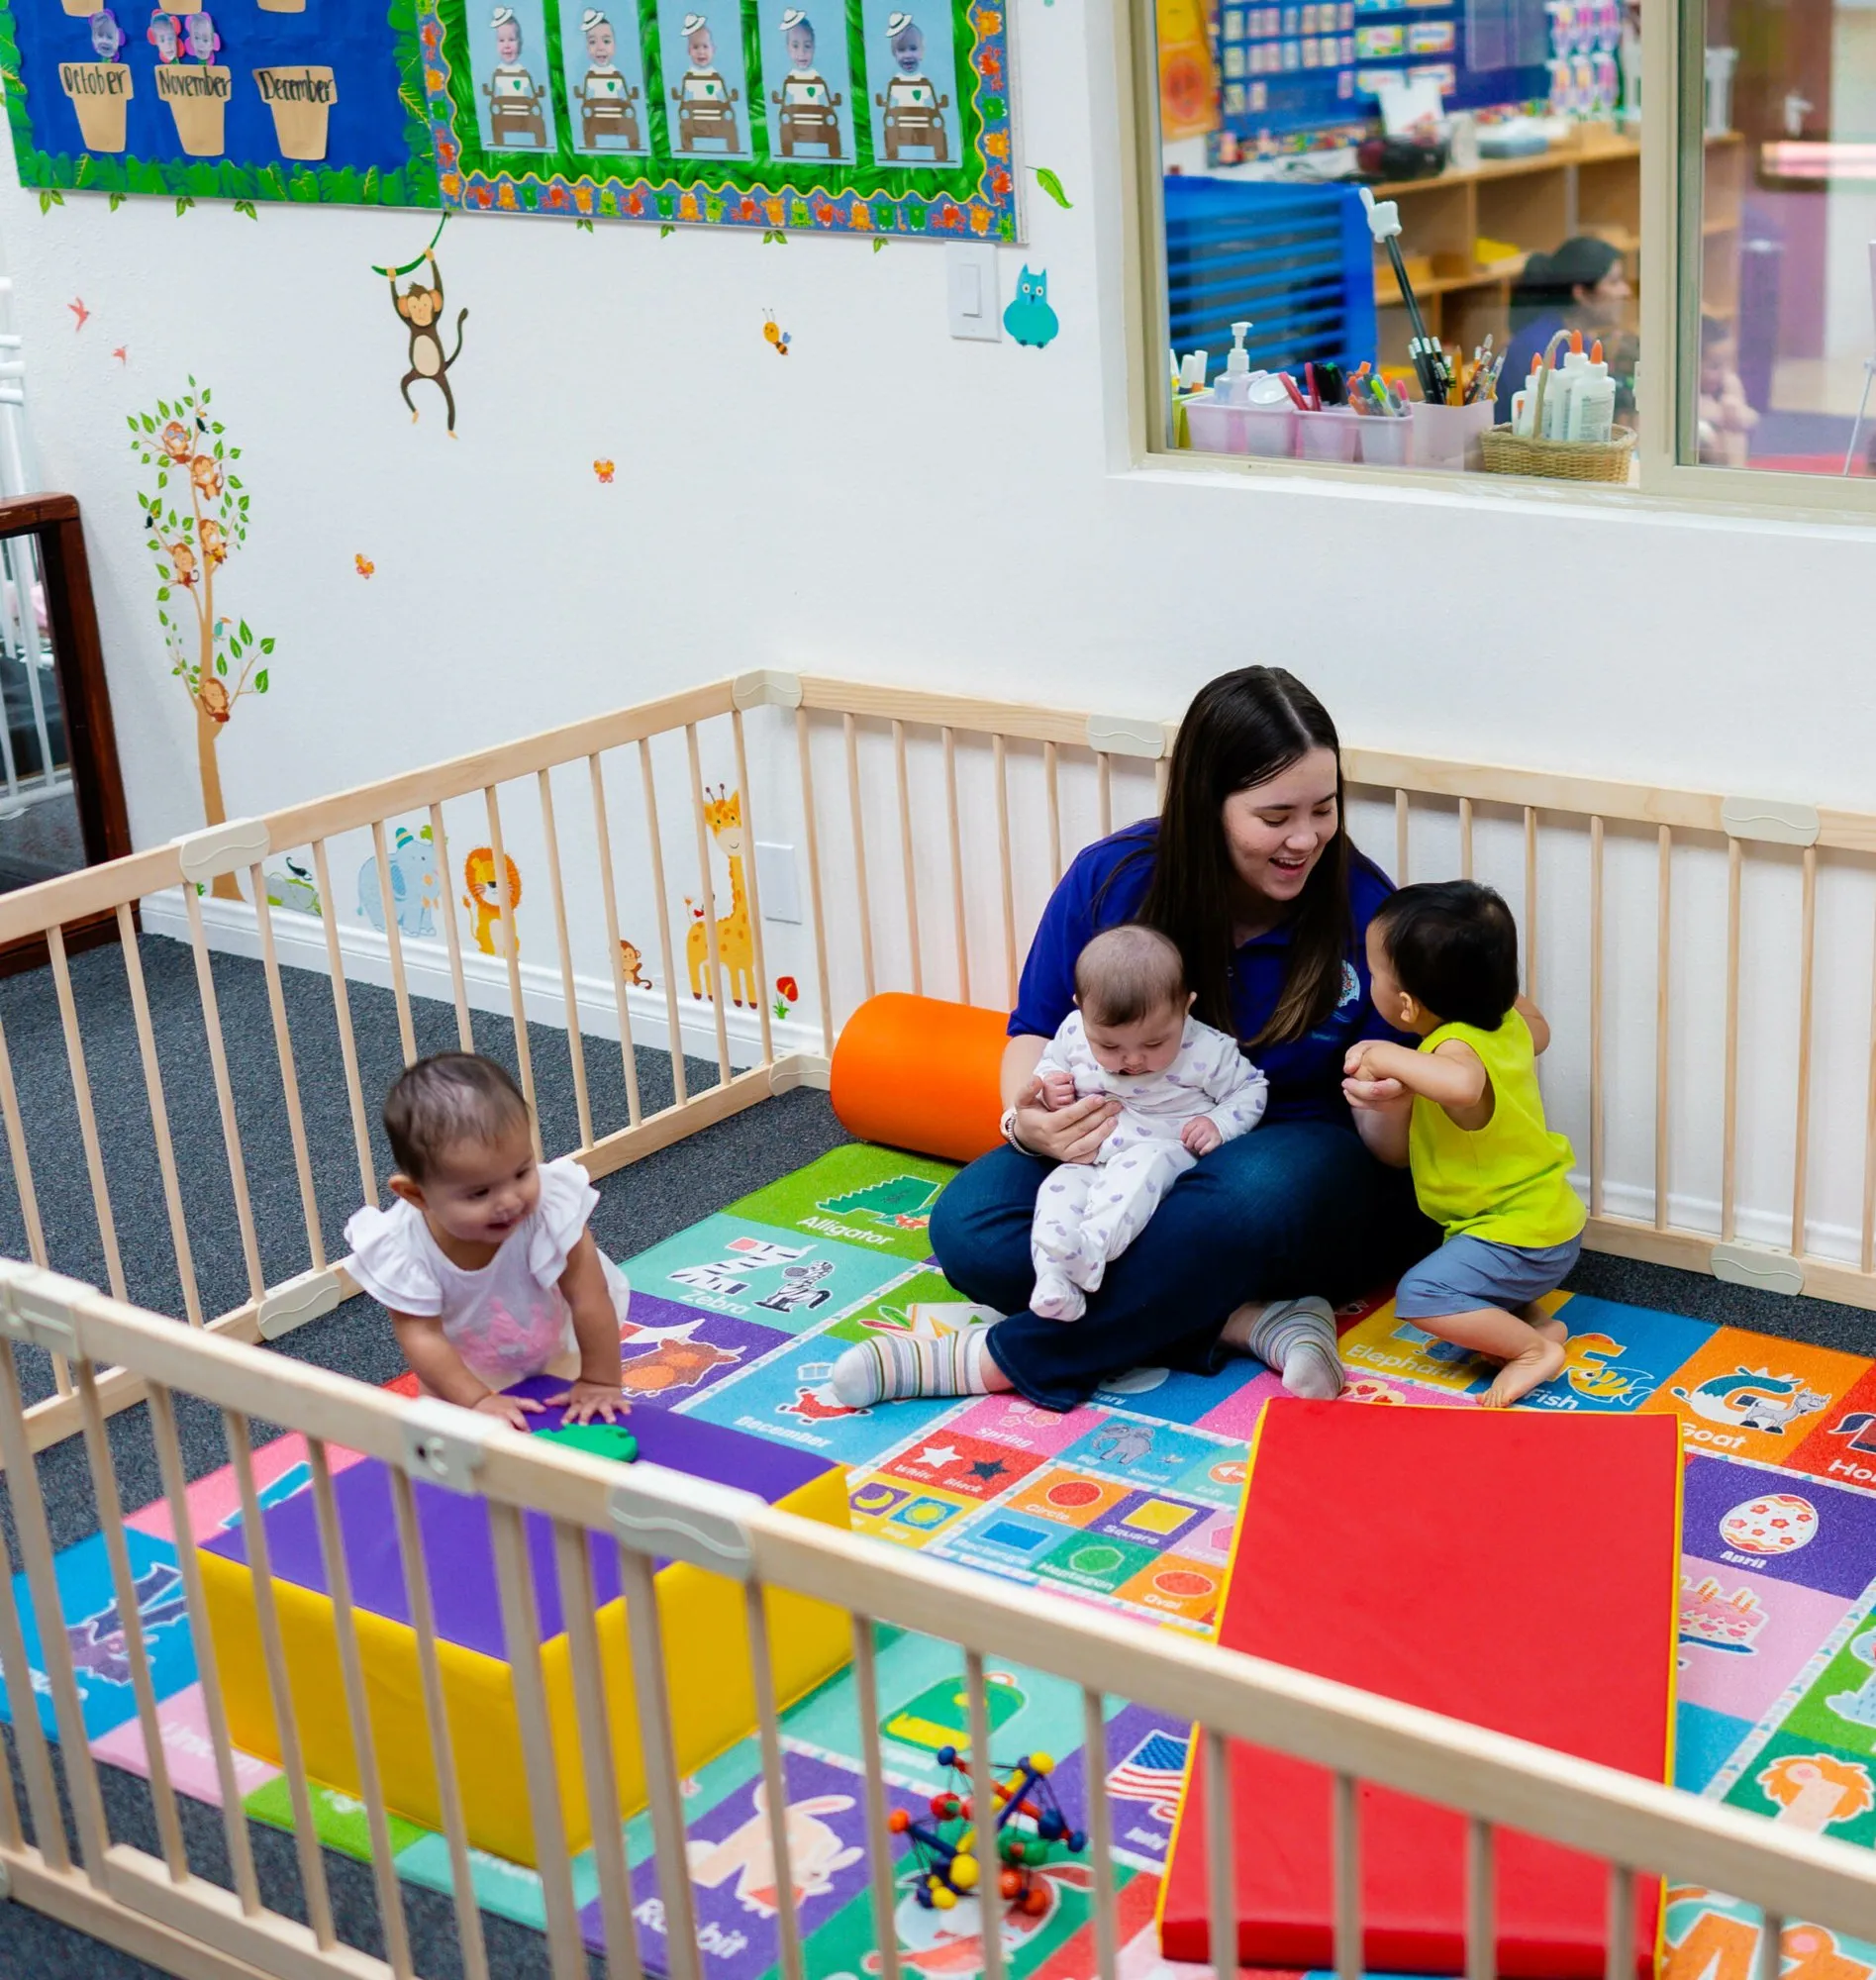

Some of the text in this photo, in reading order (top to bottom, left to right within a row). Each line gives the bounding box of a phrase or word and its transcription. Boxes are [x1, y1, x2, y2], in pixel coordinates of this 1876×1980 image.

[63, 65, 127, 95] October
[158, 66, 232, 97] November
[259, 70, 334, 103] December
[796, 1216, 895, 1245] Alligator
[679, 1290, 751, 1315] Zebra
[1345, 1343, 1465, 1380] Elephant
[1523, 1388, 1580, 1410] Fish
[733, 1416, 833, 1447] December
[975, 1428, 1035, 1448] Spring
[1681, 1422, 1747, 1448] Goat
[1026, 1504, 1070, 1522] Circle
[1103, 1524, 1159, 1545] Square
[1720, 1550, 1767, 1570] April
[1143, 1593, 1183, 1611] Oval
[632, 1897, 748, 1959] Rbit
